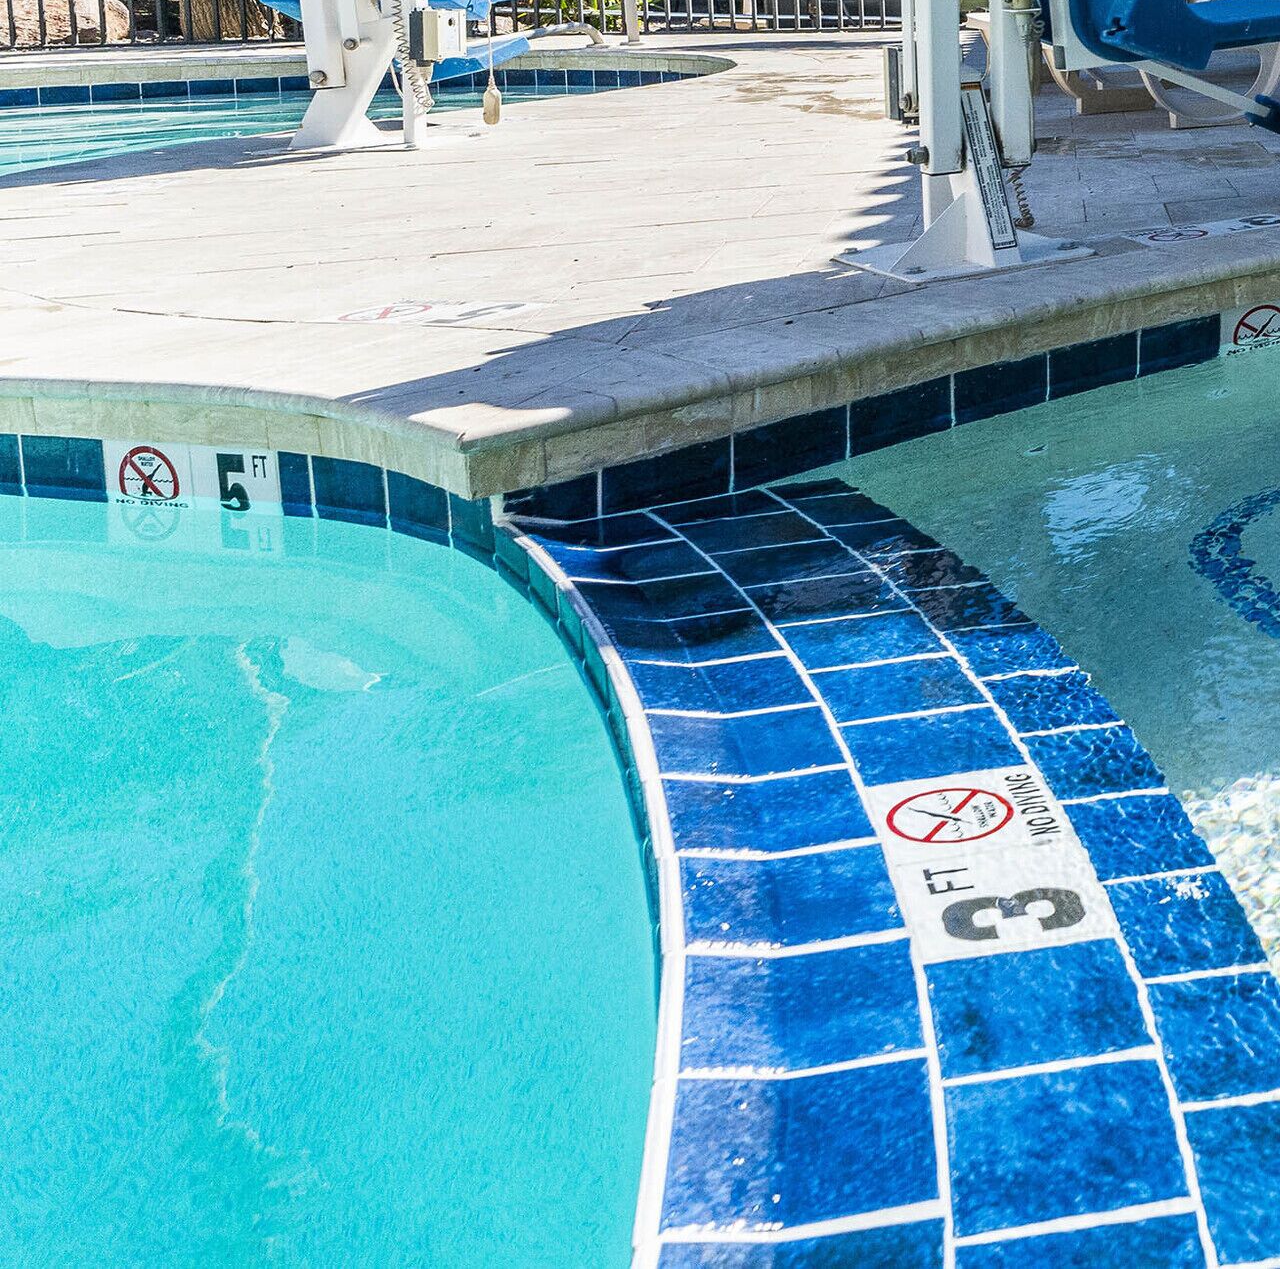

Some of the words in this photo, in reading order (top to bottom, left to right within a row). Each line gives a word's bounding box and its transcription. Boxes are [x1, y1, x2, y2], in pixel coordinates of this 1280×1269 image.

[216, 453, 251, 512] 5
[252, 455, 267, 478] FT
[116, 498, 135, 506] NO
[139, 499, 189, 509] DIVING
[1004, 773, 1050, 816] DIVING
[1026, 816, 1062, 837] NO
[922, 866, 975, 896] FT
[942, 887, 1087, 941] 3
